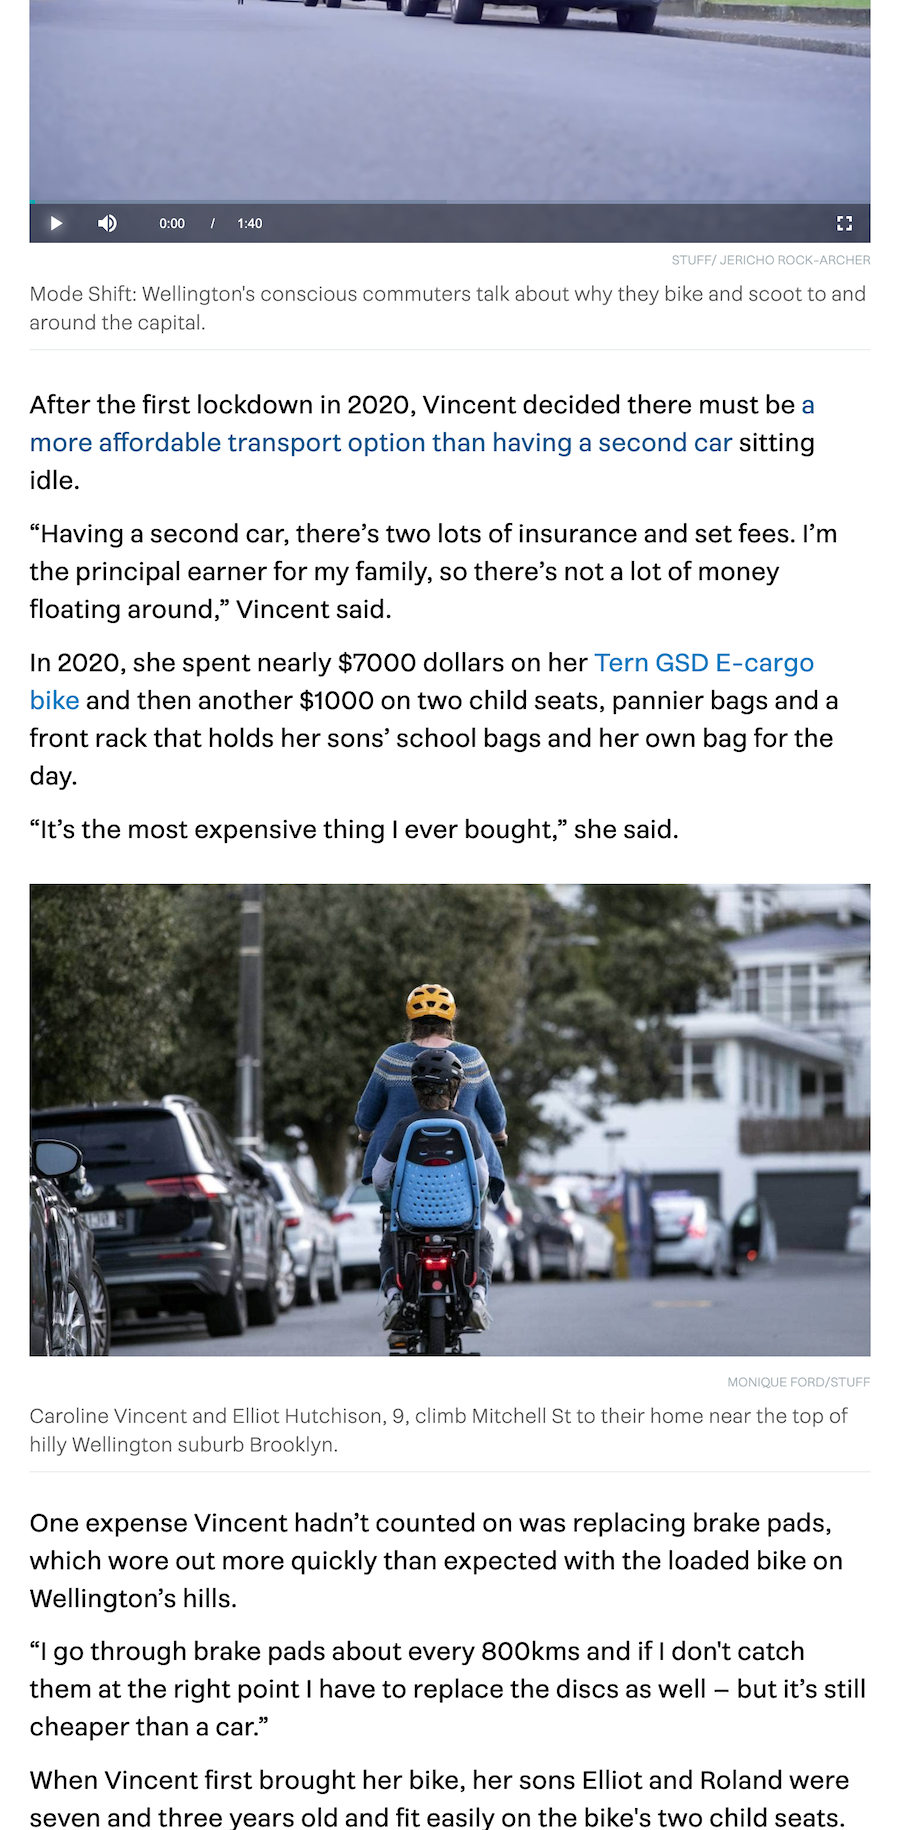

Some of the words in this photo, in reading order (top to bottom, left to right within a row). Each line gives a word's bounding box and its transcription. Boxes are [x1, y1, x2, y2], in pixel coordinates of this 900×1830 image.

[672, 255, 716, 266] STUFF/
[720, 255, 774, 265] JERICHO
[779, 255, 870, 265] ROCK-ARCHER
[30, 314, 95, 330] around
[102, 314, 132, 330] the
[138, 314, 205, 334] capital.
[31, 437, 92, 452] more
[99, 431, 221, 452] affordable
[228, 434, 341, 457] transport
[348, 433, 425, 457] option
[432, 432, 485, 452] than
[494, 432, 571, 457] having
[579, 437, 591, 452] a
[599, 432, 686, 452] second
[695, 437, 733, 452] car
[740, 433, 814, 457] sitting
[31, 653, 50, 672] In
[58, 653, 125, 675] 2020,
[133, 652, 175, 672] she
[183, 654, 251, 677] spent
[258, 652, 332, 677] nearly
[338, 652, 416, 674] $7000
[424, 652, 504, 672] dollars
[511, 657, 540, 672] on
[549, 652, 588, 672] her
[594, 653, 648, 672] Tern
[656, 653, 708, 672] GSD
[717, 653, 814, 677] E-cargo
[728, 1377, 786, 1388] MONIQUE
[791, 1377, 870, 1388] FORD/STUFF
[31, 1436, 67, 1456] hilly
[72, 1436, 171, 1456] Wellington
[178, 1436, 244, 1452] suburb
[251, 1436, 337, 1456] Brooklyn.
[30, 1588, 176, 1613] Wellington’s
[184, 1588, 236, 1608] hills.
